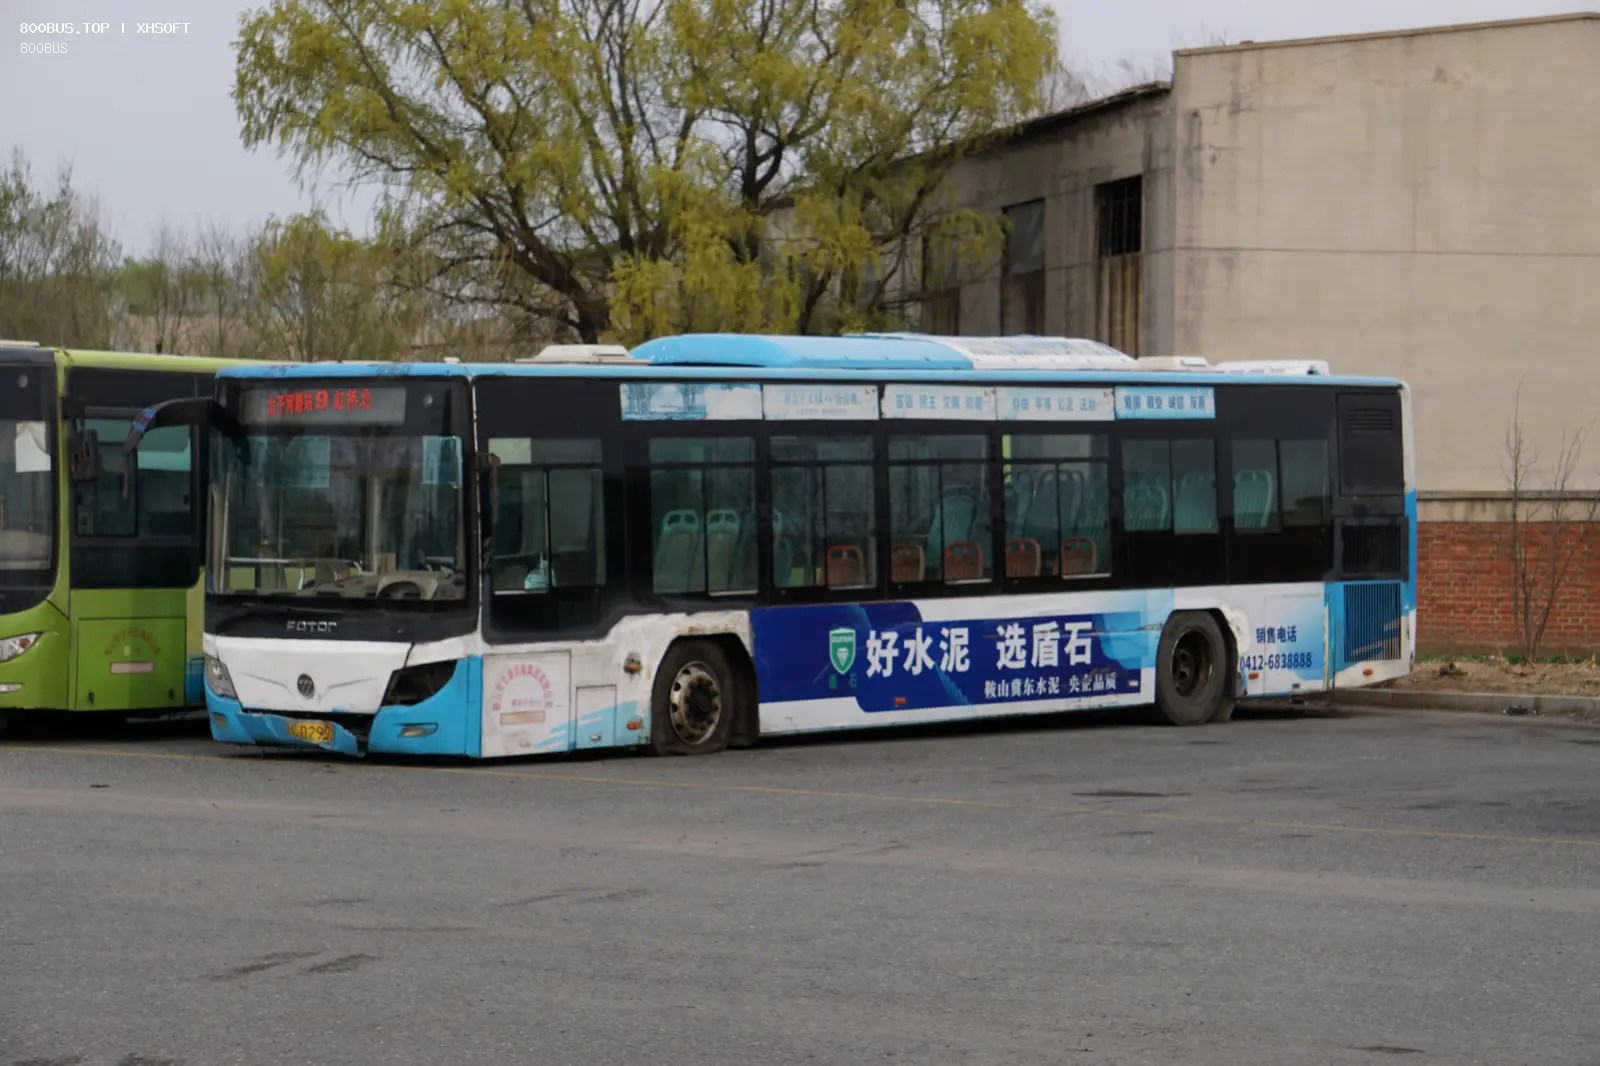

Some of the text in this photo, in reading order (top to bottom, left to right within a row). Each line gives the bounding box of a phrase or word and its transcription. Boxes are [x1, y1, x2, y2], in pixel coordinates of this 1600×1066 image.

[315, 389, 329, 410] 9
[919, 394, 936, 409] 民主
[1058, 397, 1074, 412] 公正
[1256, 625, 1297, 644] 销售电话
[866, 621, 1093, 678] 好水泥 选盾石
[1240, 652, 1313, 671] 0412-6838888
[984, 672, 1117, 699] 鞍山冀东水泥 央企品质
